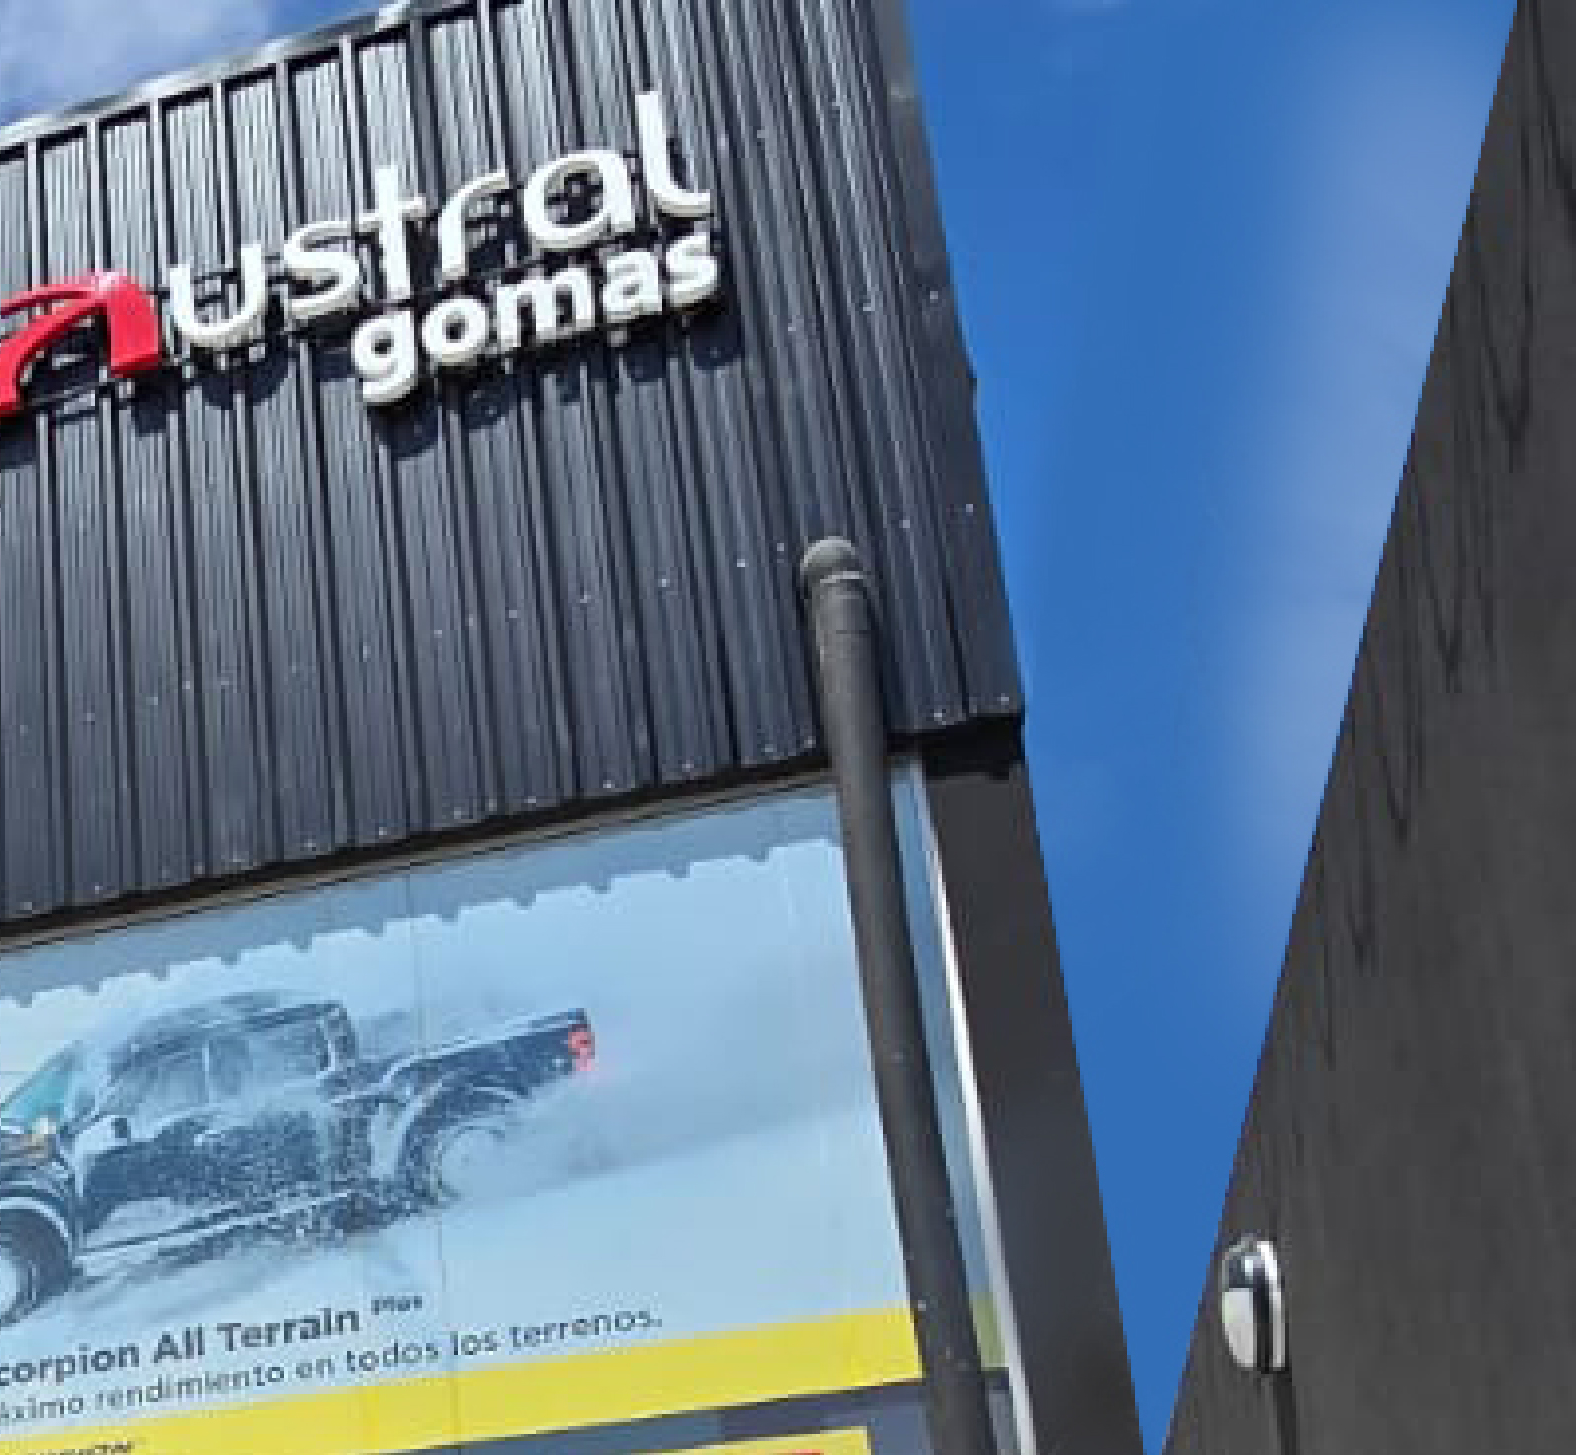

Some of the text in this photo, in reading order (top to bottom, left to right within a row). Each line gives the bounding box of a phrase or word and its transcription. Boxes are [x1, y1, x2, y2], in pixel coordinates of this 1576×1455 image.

[351, 229, 719, 404] gomas
[153, 1322, 206, 1364] All
[216, 1307, 360, 1352] Terrain
[296, 1356, 336, 1379] en
[346, 1343, 439, 1373] todos
[450, 1330, 500, 1356] los
